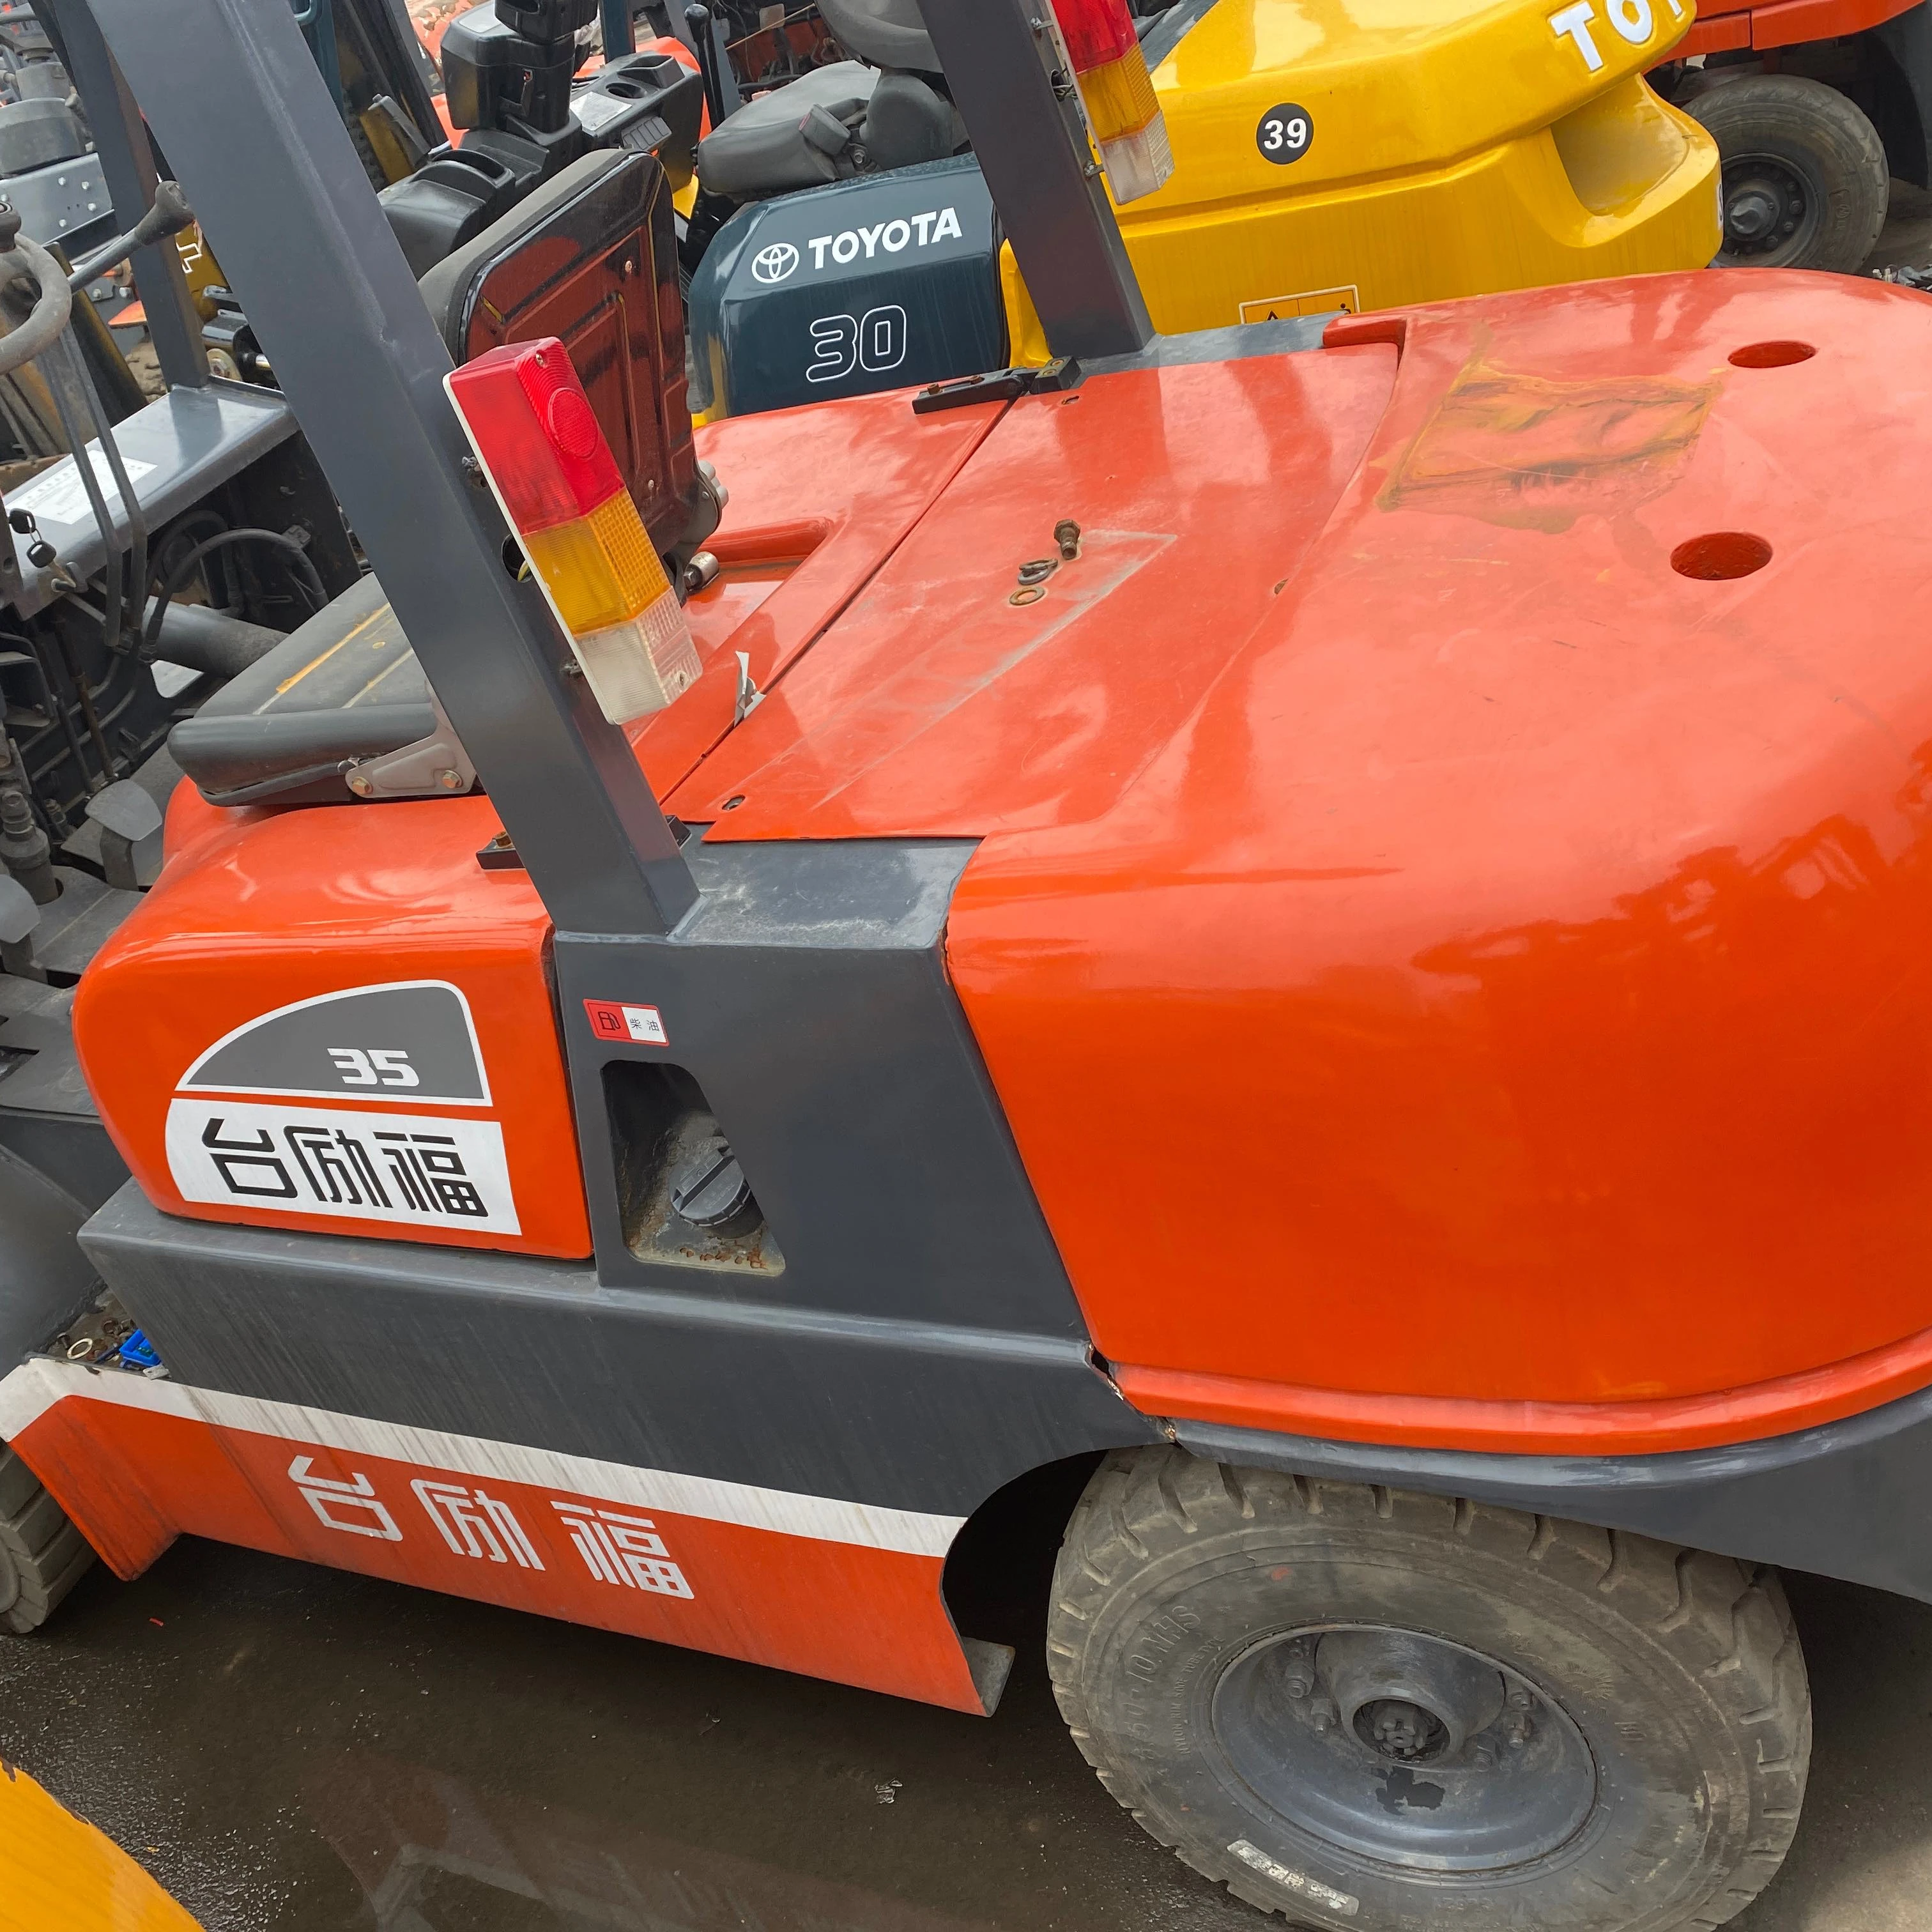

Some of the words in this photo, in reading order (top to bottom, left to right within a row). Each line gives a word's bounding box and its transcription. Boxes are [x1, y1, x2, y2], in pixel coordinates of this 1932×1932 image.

[1551, 0, 1682, 71] TO
[1264, 119, 1306, 149] 39
[809, 208, 962, 269] TOYOTA
[806, 305, 906, 382] 30
[629, 1017, 661, 1032] 柴油
[327, 1048, 419, 1087] 35
[203, 1117, 489, 1218] 台励福
[288, 1455, 695, 1600] 台励福
